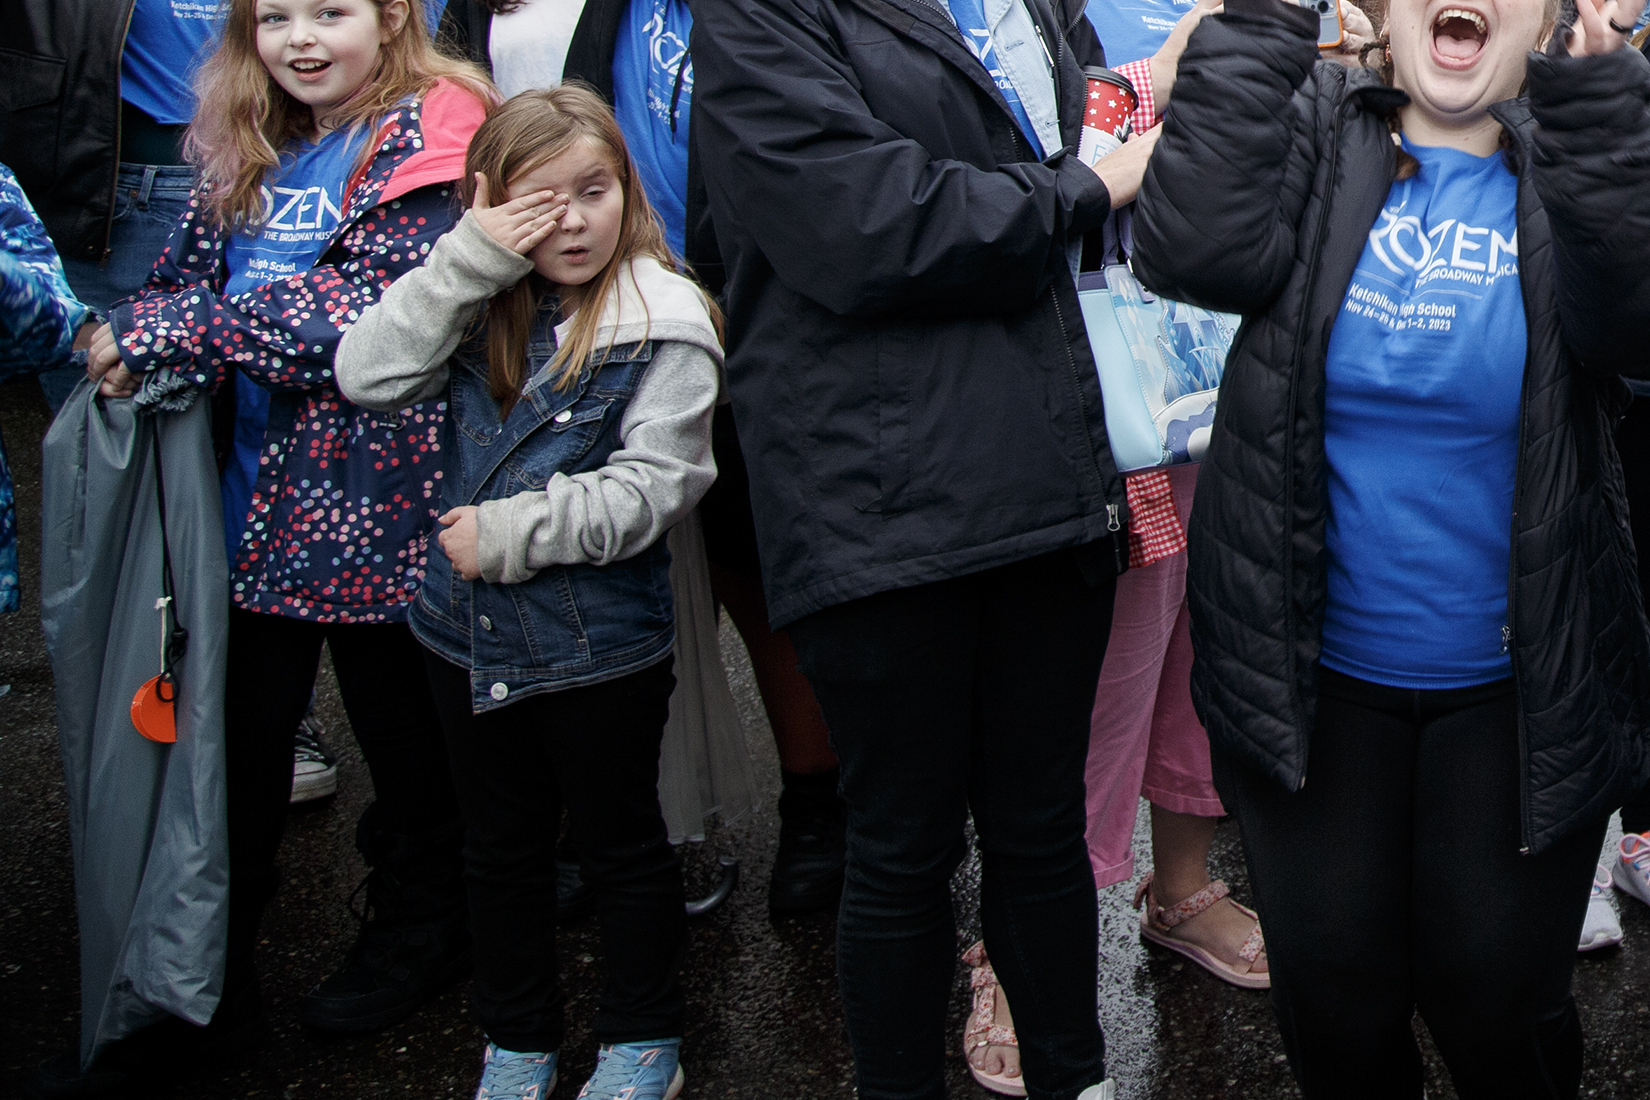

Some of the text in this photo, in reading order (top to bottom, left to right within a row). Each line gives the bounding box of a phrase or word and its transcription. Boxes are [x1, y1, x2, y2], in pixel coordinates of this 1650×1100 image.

[205, 4, 219, 14] Hig
[264, 230, 278, 241] THE
[1427, 267, 1484, 286] BROADWAY
[1348, 282, 1457, 319] Ketchikan igh School
[1345, 298, 1361, 314] Nov
[1429, 318, 1452, 331] 2023
